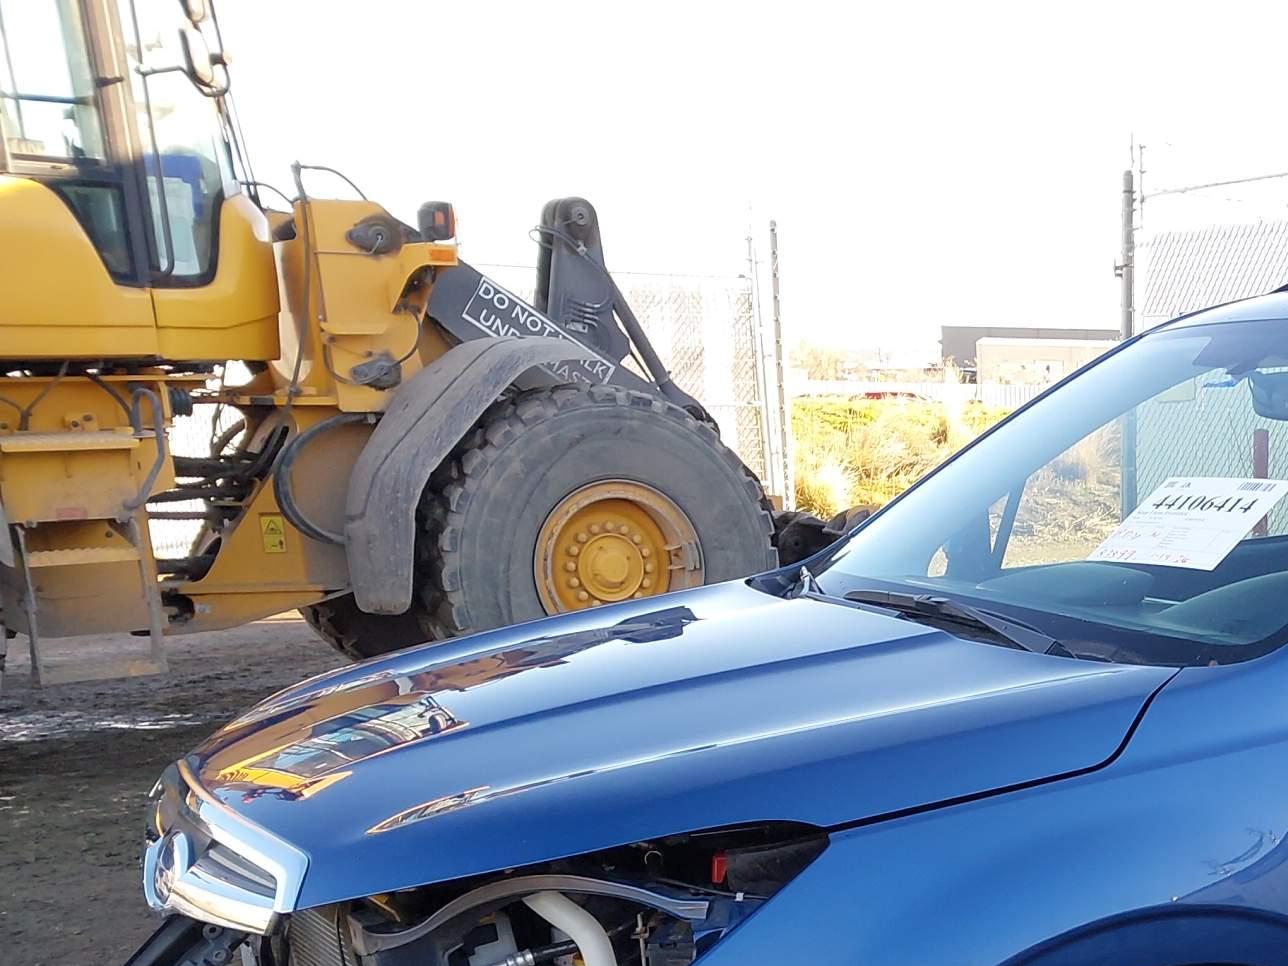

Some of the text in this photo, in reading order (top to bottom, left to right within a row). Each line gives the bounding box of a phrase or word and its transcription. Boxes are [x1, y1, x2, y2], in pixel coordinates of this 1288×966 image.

[478, 282, 509, 310] DO
[511, 305, 555, 337] NOT
[1152, 495, 1259, 514] 44106414
